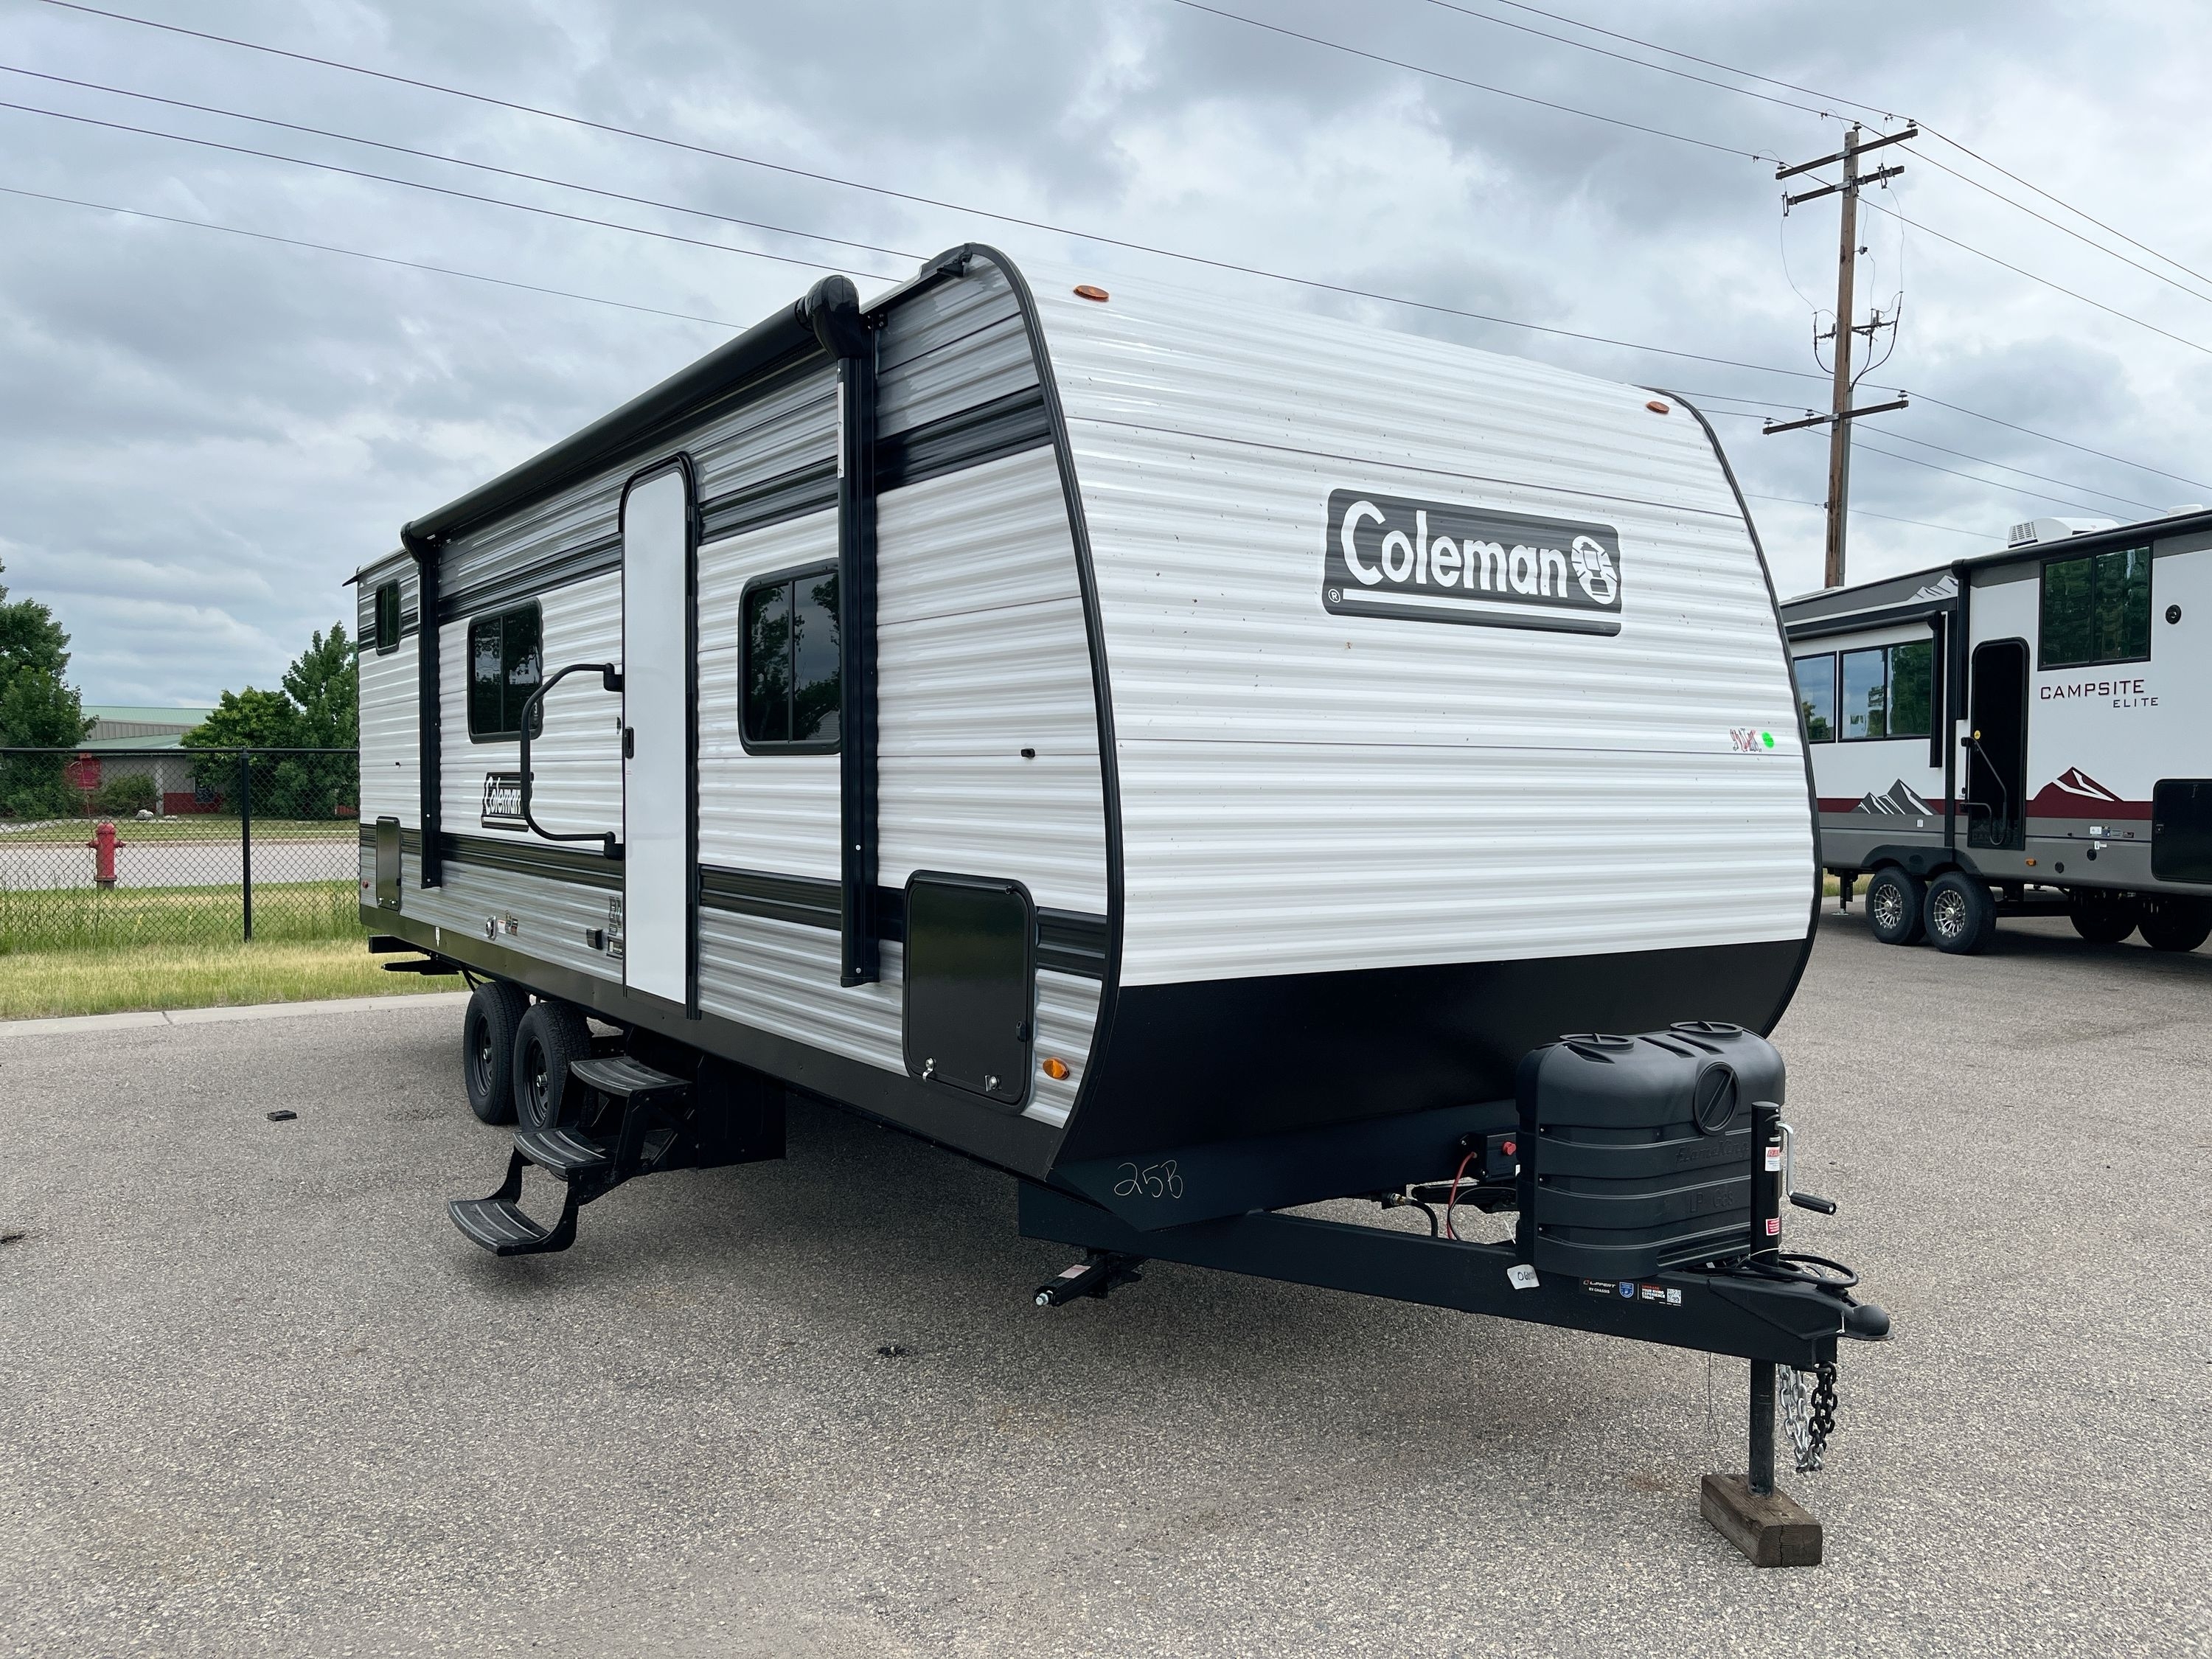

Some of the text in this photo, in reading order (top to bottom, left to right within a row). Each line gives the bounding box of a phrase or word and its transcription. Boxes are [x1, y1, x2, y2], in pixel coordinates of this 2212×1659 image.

[1340, 500, 1568, 598] Coleman
[2040, 679, 2145, 700] CAMPSITE
[2112, 697, 2159, 709] ELITE
[484, 776, 521, 815] Coleman
[1114, 1160, 1183, 1199] 25B
